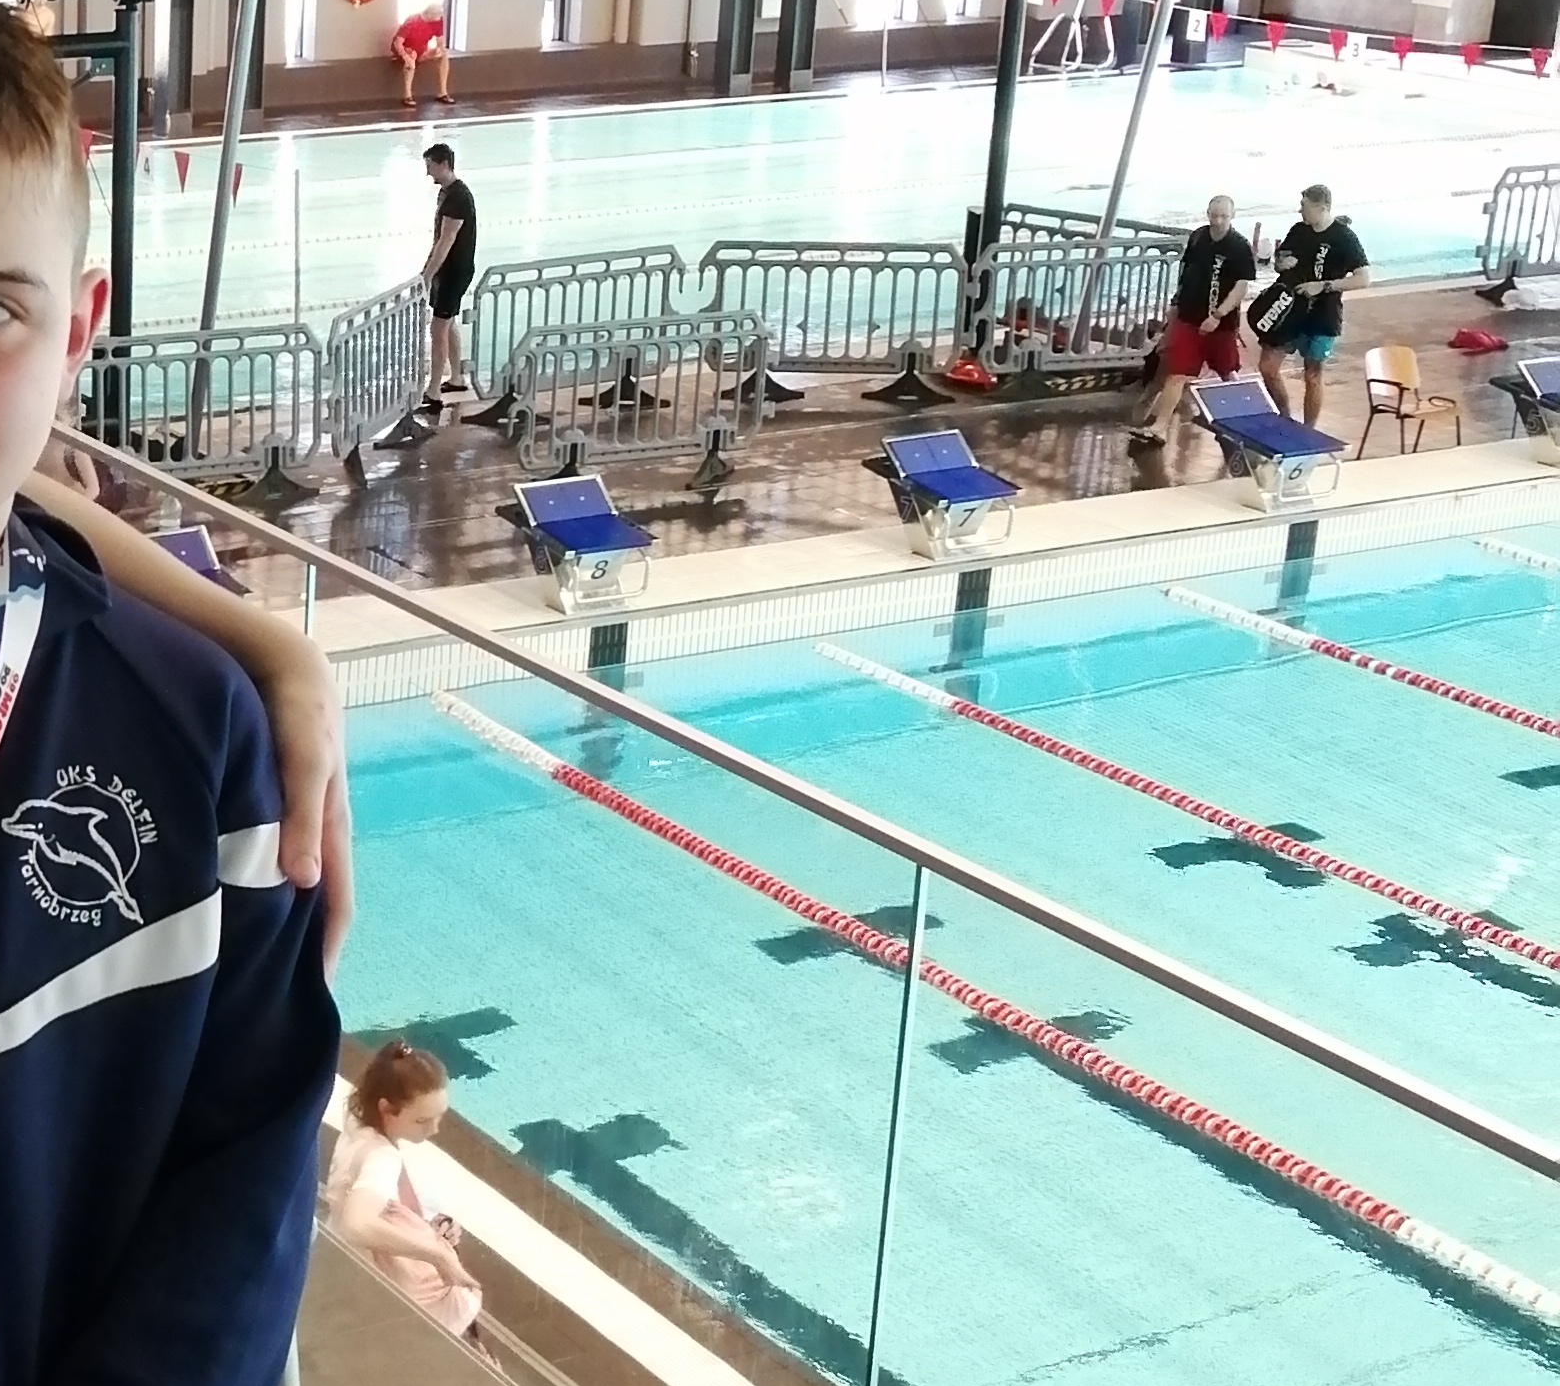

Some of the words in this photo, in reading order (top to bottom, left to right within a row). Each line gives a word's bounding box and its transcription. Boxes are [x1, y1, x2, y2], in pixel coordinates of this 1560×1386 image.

[1352, 42, 1360, 58] 3
[1256, 291, 1293, 332] arena
[1288, 462, 1303, 481] 6
[900, 495, 914, 523] 7
[958, 507, 978, 528] 7
[590, 559, 609, 580] 8
[56, 764, 97, 787] UKS
